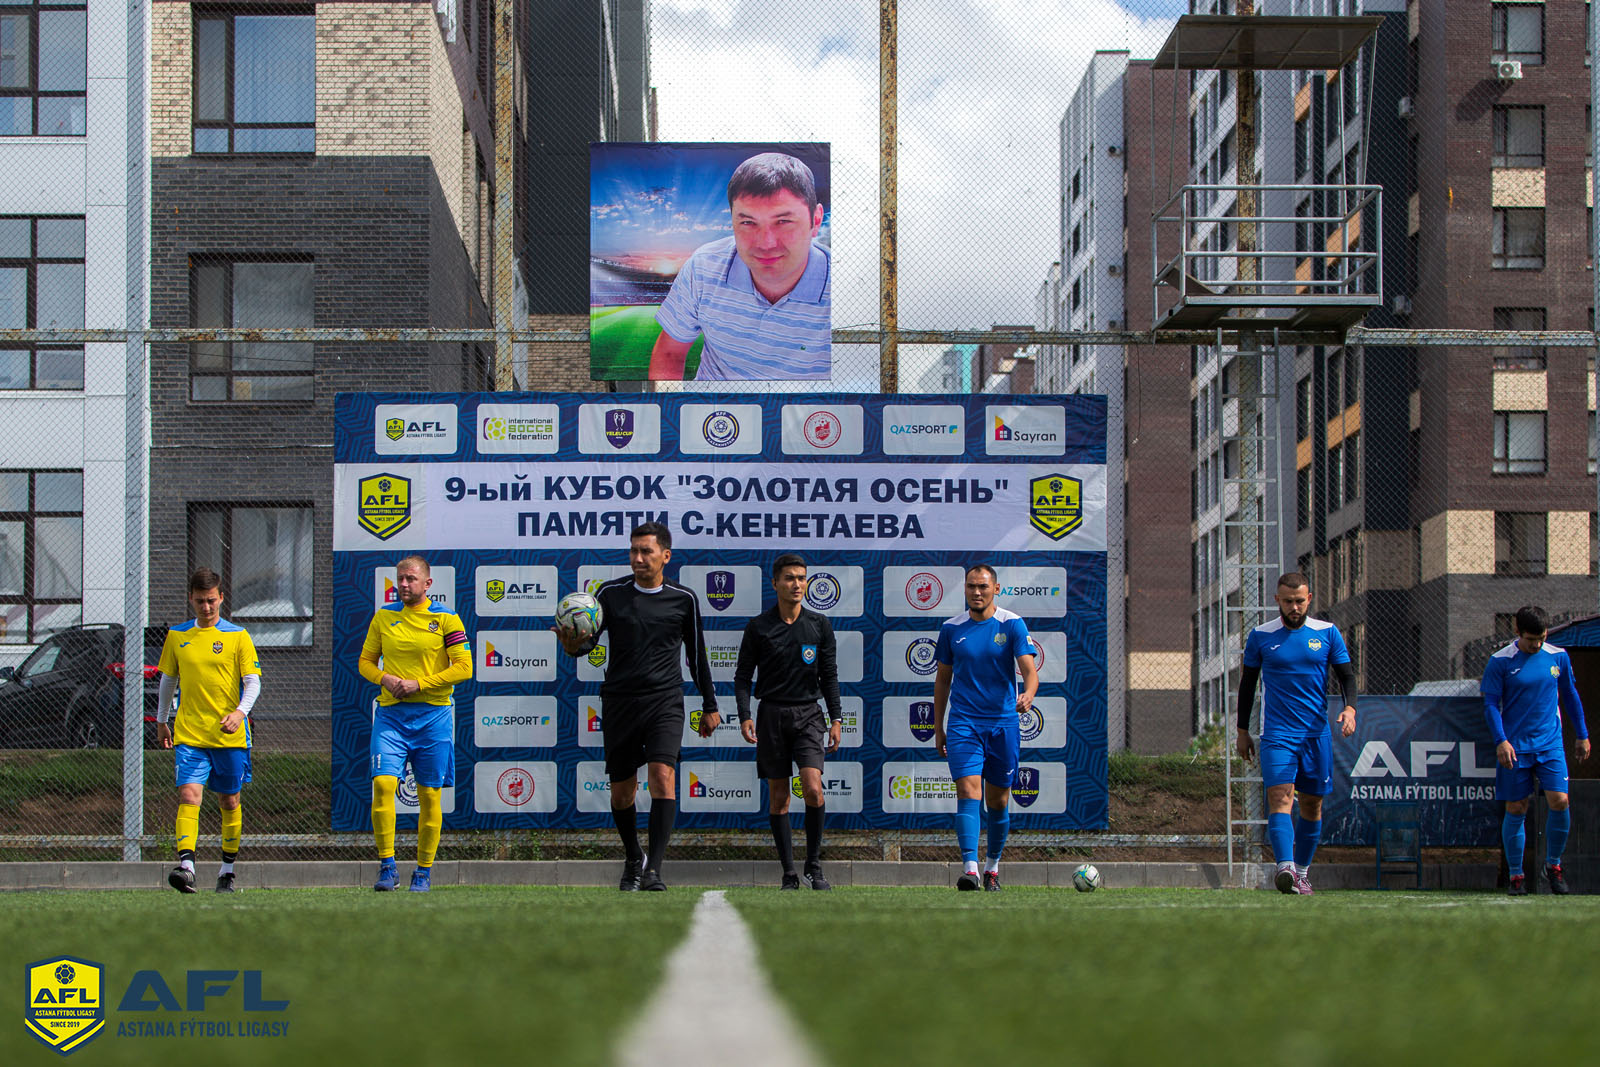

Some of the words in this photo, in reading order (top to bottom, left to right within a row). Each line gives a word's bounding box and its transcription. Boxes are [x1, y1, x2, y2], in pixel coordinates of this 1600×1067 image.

[407, 421, 446, 432] AFL
[890, 424, 946, 434] QAZSPORT
[1014, 431, 1057, 443] Sayran
[445, 474, 531, 502] 9-ый
[544, 475, 667, 501] КУБОК
[678, 475, 858, 502] "ЗОЛОТАЯ
[870, 478, 1008, 503] ОСЕНЬ"
[364, 494, 405, 505] AFL
[1035, 495, 1077, 505] AFL
[681, 511, 924, 538] С.КЕНЕТАЕВА
[507, 583, 547, 593] AFL
[998, 586, 1049, 597] AZSPORT
[504, 656, 548, 669] Sayran
[481, 716, 539, 727] QAZSPORT
[1350, 740, 1496, 777] AFL
[708, 787, 752, 800] Sayran
[1350, 784, 1402, 800] ASTANA
